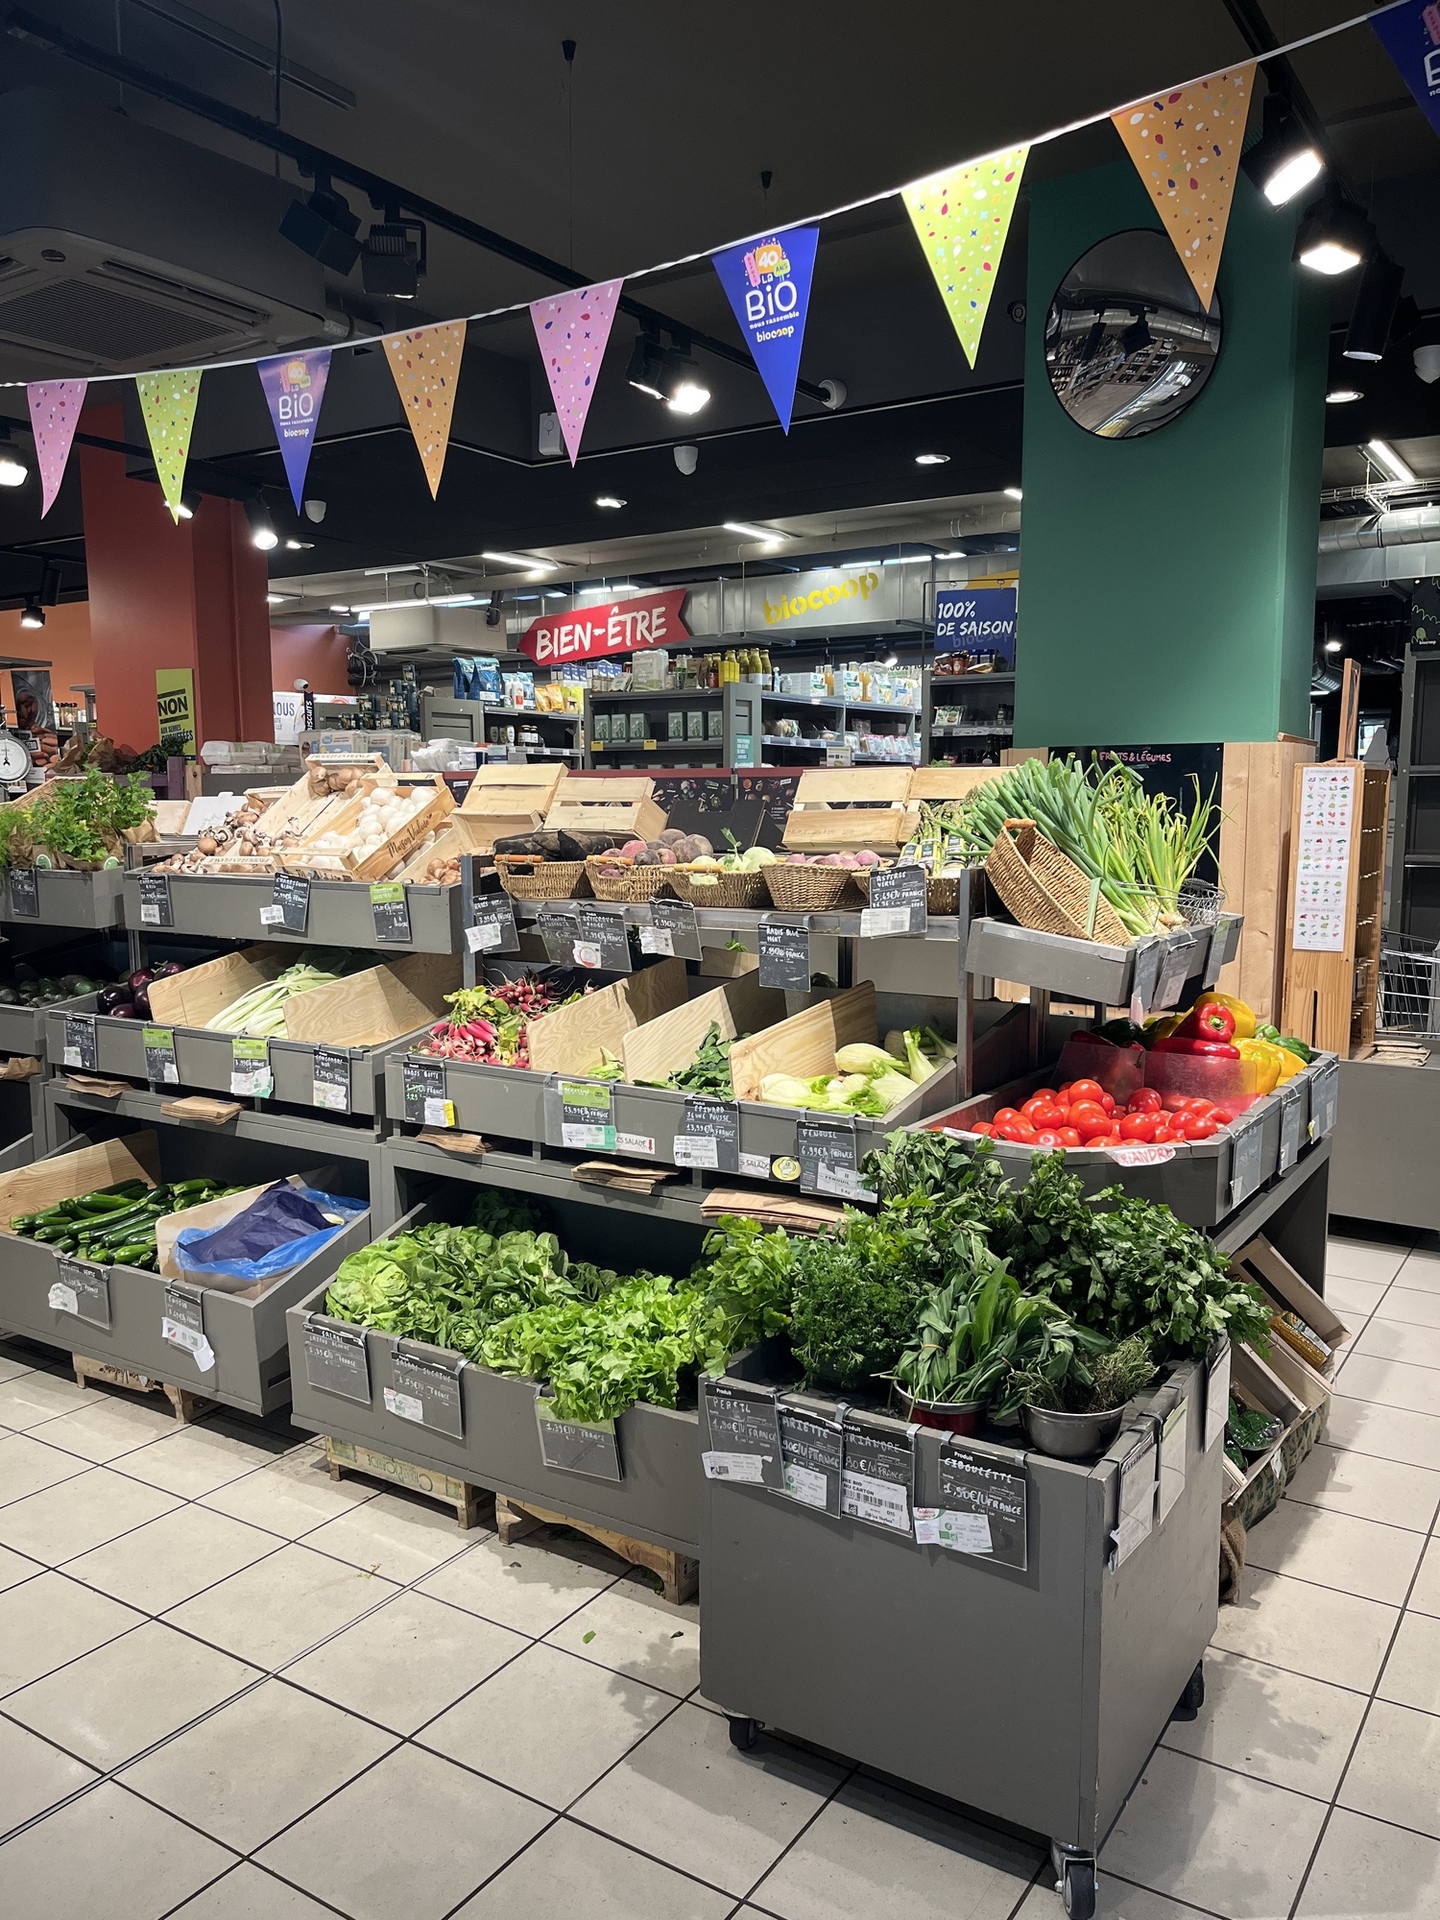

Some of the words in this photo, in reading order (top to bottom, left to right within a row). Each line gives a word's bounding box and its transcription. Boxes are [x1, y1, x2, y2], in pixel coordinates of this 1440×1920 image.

[758, 250, 779, 268] 40
[775, 263, 789, 272] ANS
[762, 273, 773, 284] La
[750, 322, 766, 330] nous
[766, 310, 800, 326] rassemble
[756, 325, 794, 343] biocoop
[763, 572, 879, 625] biocoop
[938, 601, 976, 620] 100%
[536, 606, 667, 661] BIEN-ÊTRE
[937, 622, 956, 637] DE
[959, 620, 1014, 638] SAISON
[158, 696, 188, 717] NON
[902, 890, 924, 898] FRANCE
[803, 1129, 838, 1139] FENOUIL
[625, 1137, 646, 1147] SALADE
[830, 1148, 854, 1159] FRANCE
[1117, 1148, 1173, 1164] RIANDRE
[748, 1428, 777, 1442] FRANCE
[843, 1424, 861, 1432] Produit
[954, 1451, 974, 1461] Produit
[852, 1485, 875, 1495] CARTON
[987, 1498, 1022, 1514] FRANCE
